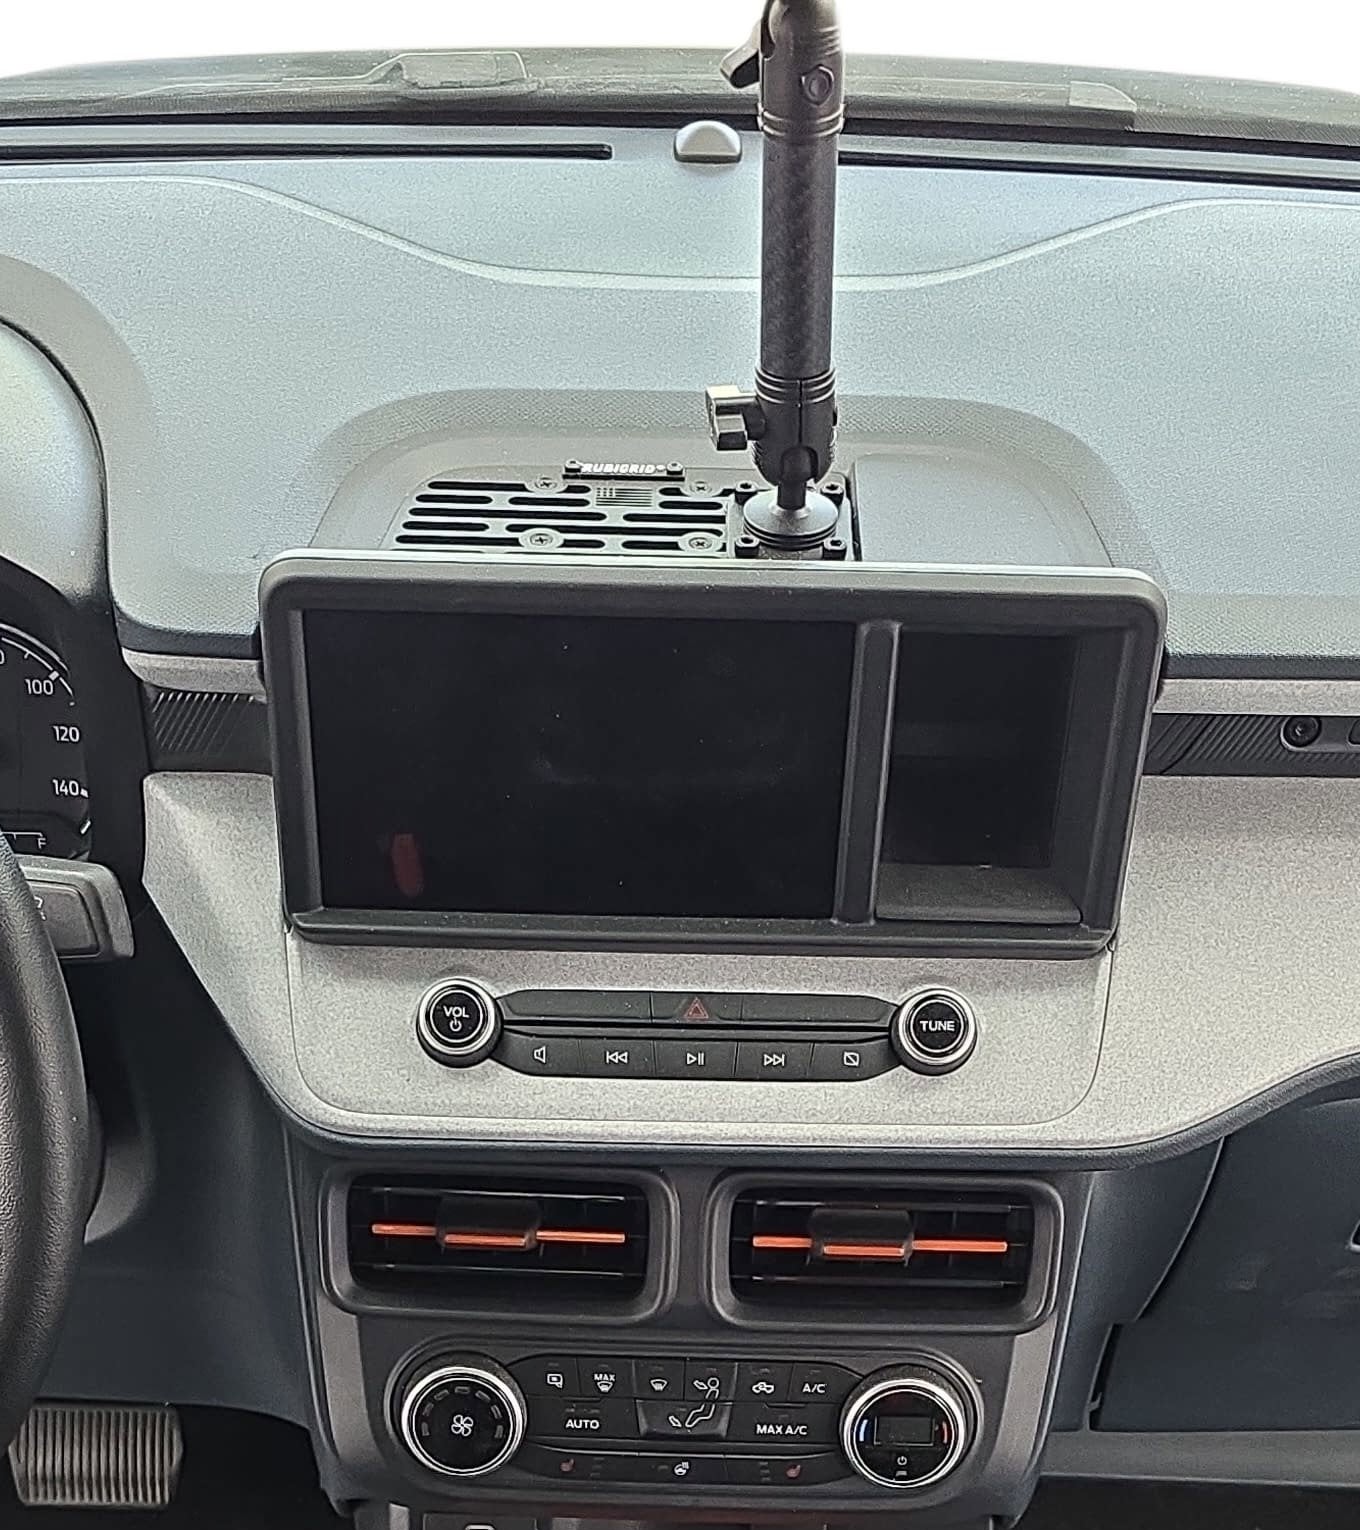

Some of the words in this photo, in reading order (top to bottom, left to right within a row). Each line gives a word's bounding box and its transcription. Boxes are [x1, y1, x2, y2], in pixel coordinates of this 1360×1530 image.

[25, 678, 54, 695] 100
[53, 725, 80, 742] 120
[52, 779, 79, 796] 140
[38, 837, 47, 849] F
[443, 1005, 469, 1018] VOL
[920, 1020, 955, 1032] TUNE
[593, 1373, 616, 1382] MAX
[802, 1383, 826, 1393] A/C
[565, 1419, 600, 1430] AUTO
[756, 1424, 783, 1435] MAX
[784, 1424, 808, 1436] A/C
